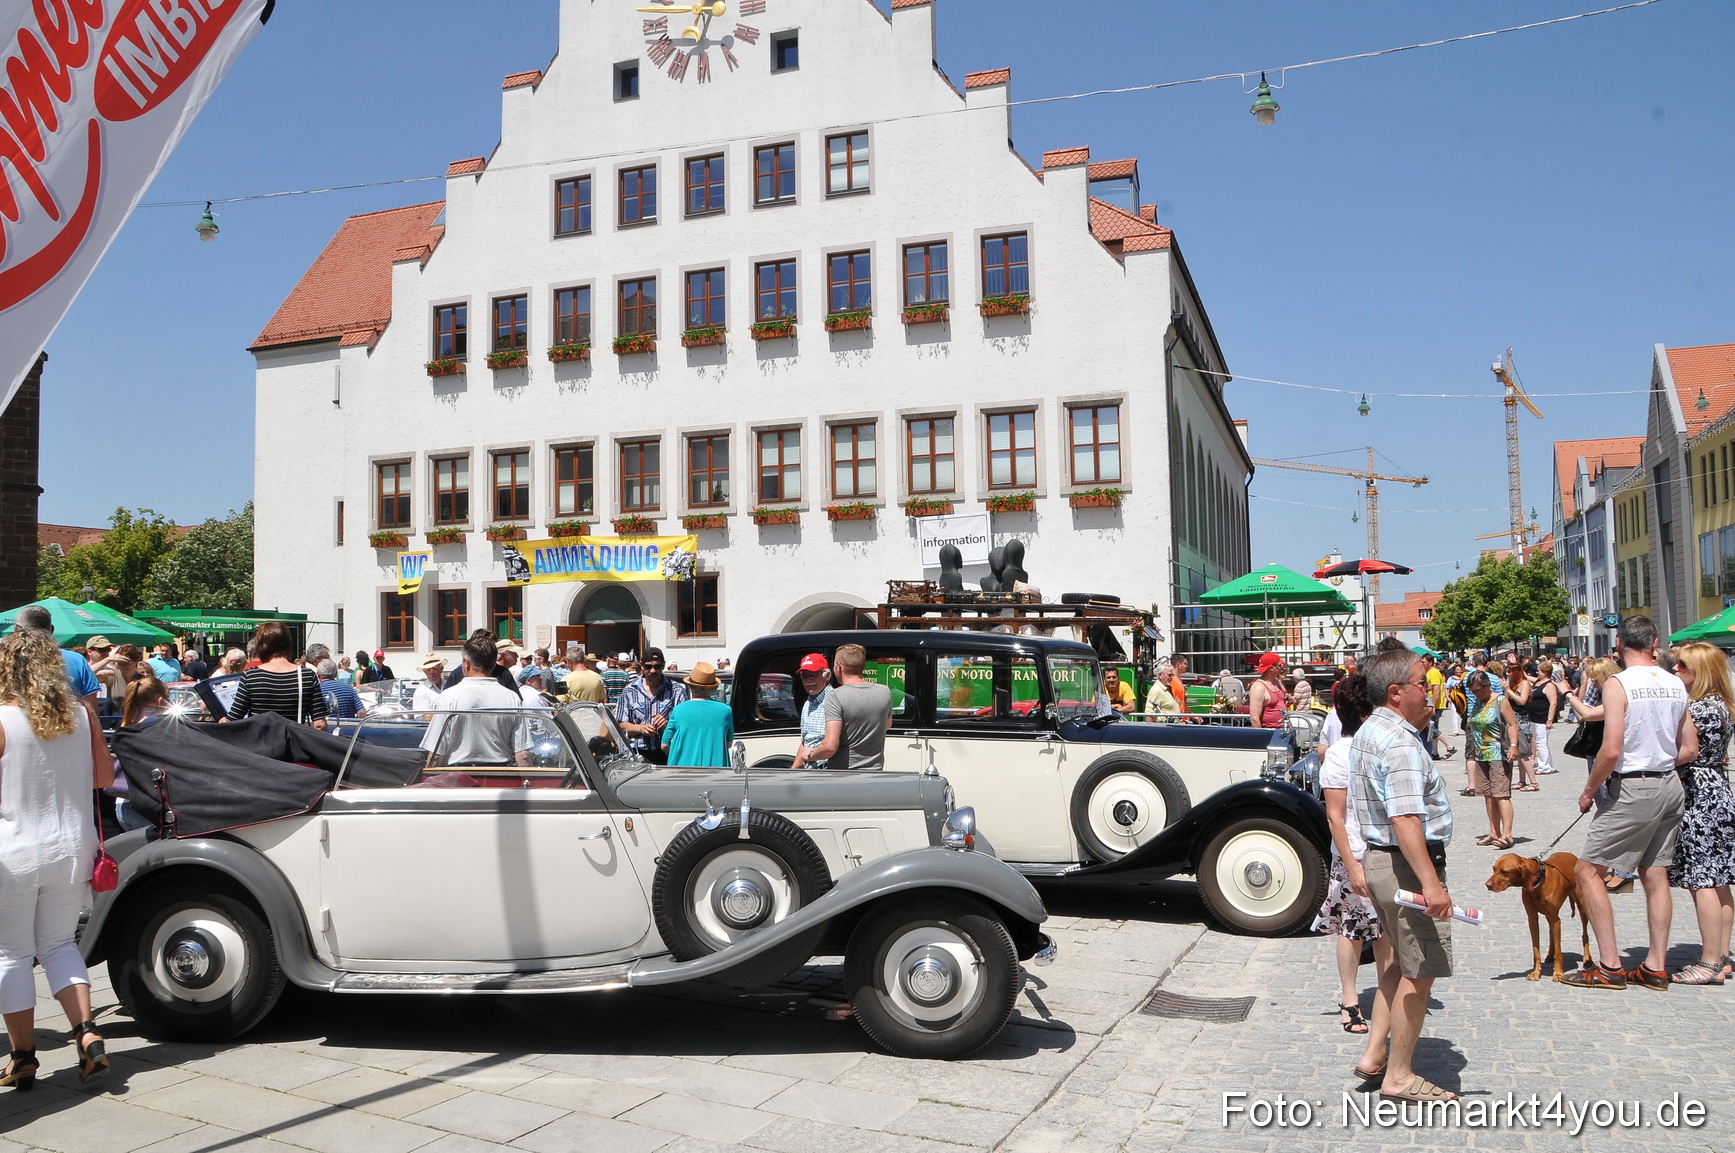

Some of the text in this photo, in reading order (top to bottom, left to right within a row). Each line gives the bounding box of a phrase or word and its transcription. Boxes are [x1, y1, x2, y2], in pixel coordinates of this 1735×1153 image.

[923, 534, 987, 548] Information
[534, 544, 660, 576] ANMELDUNG
[171, 620, 211, 629] Neumarkter
[212, 621, 253, 630] Lammsbräu
[961, 669, 994, 680] MOTO
[1630, 687, 1683, 700] BERKELEY
